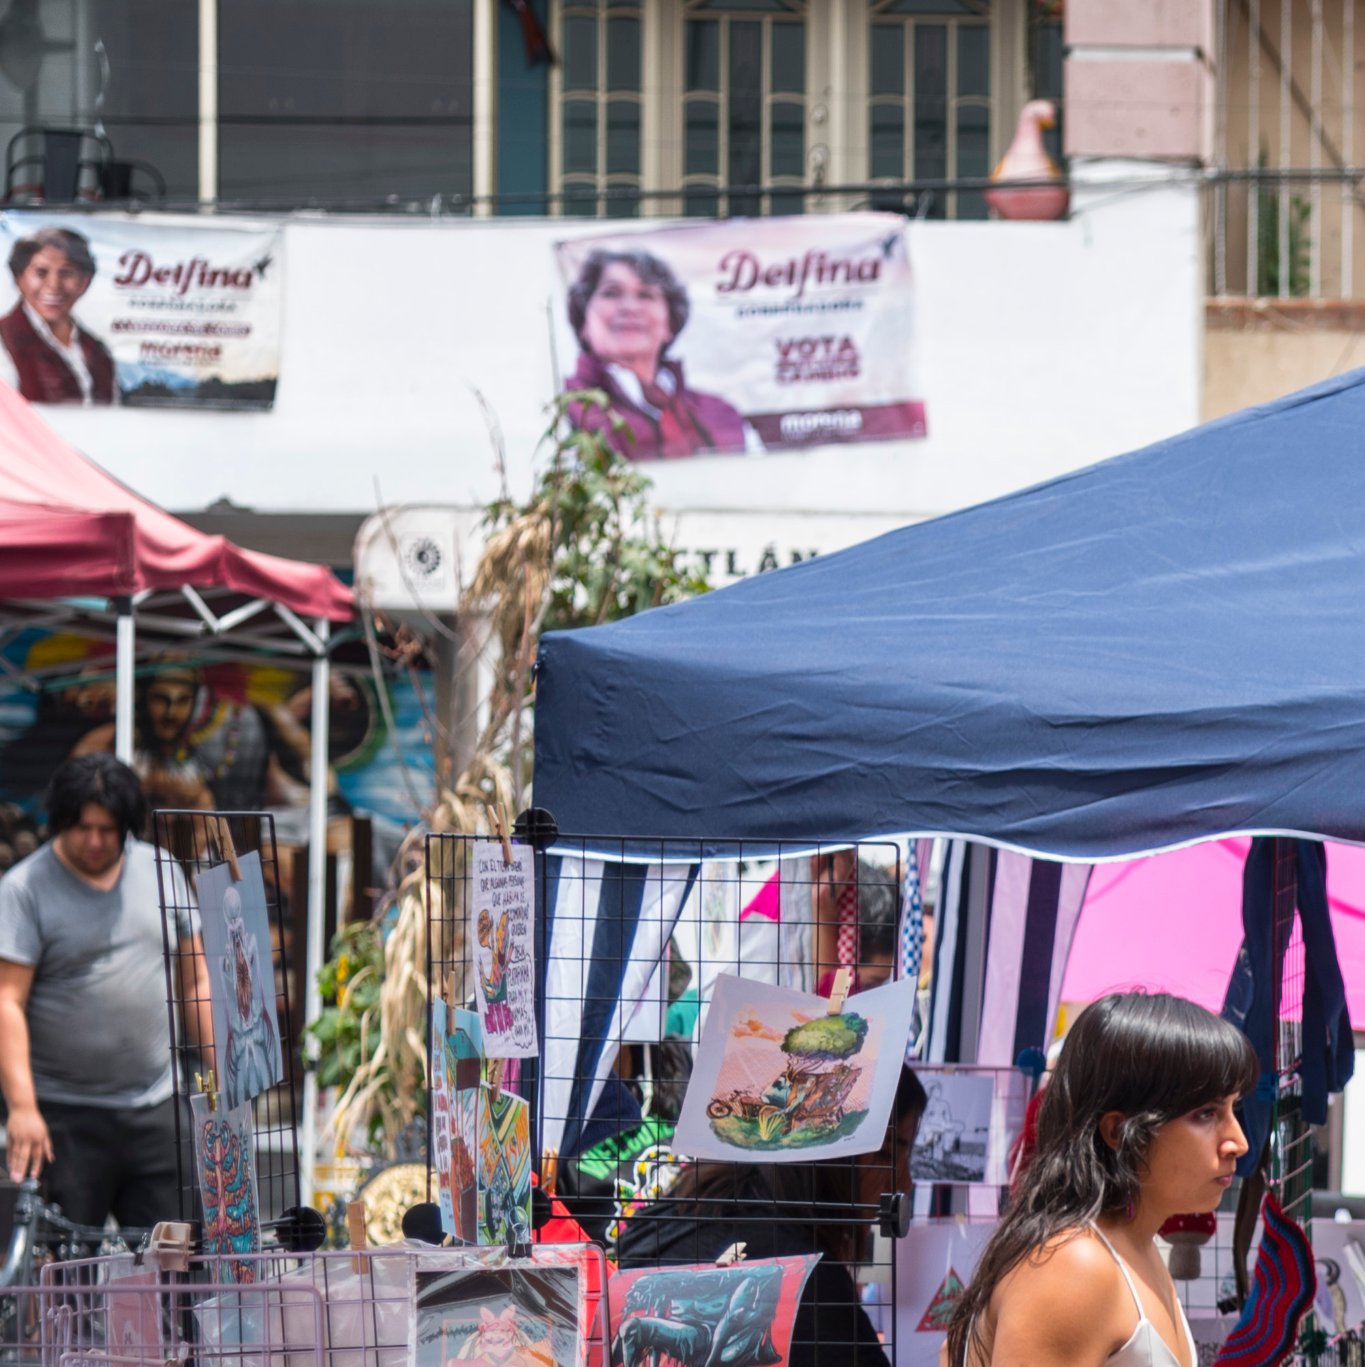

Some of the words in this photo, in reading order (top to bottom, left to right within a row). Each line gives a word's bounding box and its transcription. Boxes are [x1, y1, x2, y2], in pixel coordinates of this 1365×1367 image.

[114, 250, 253, 295] Delfina
[716, 249, 881, 299] Delfina
[776, 335, 860, 358] VOTA
